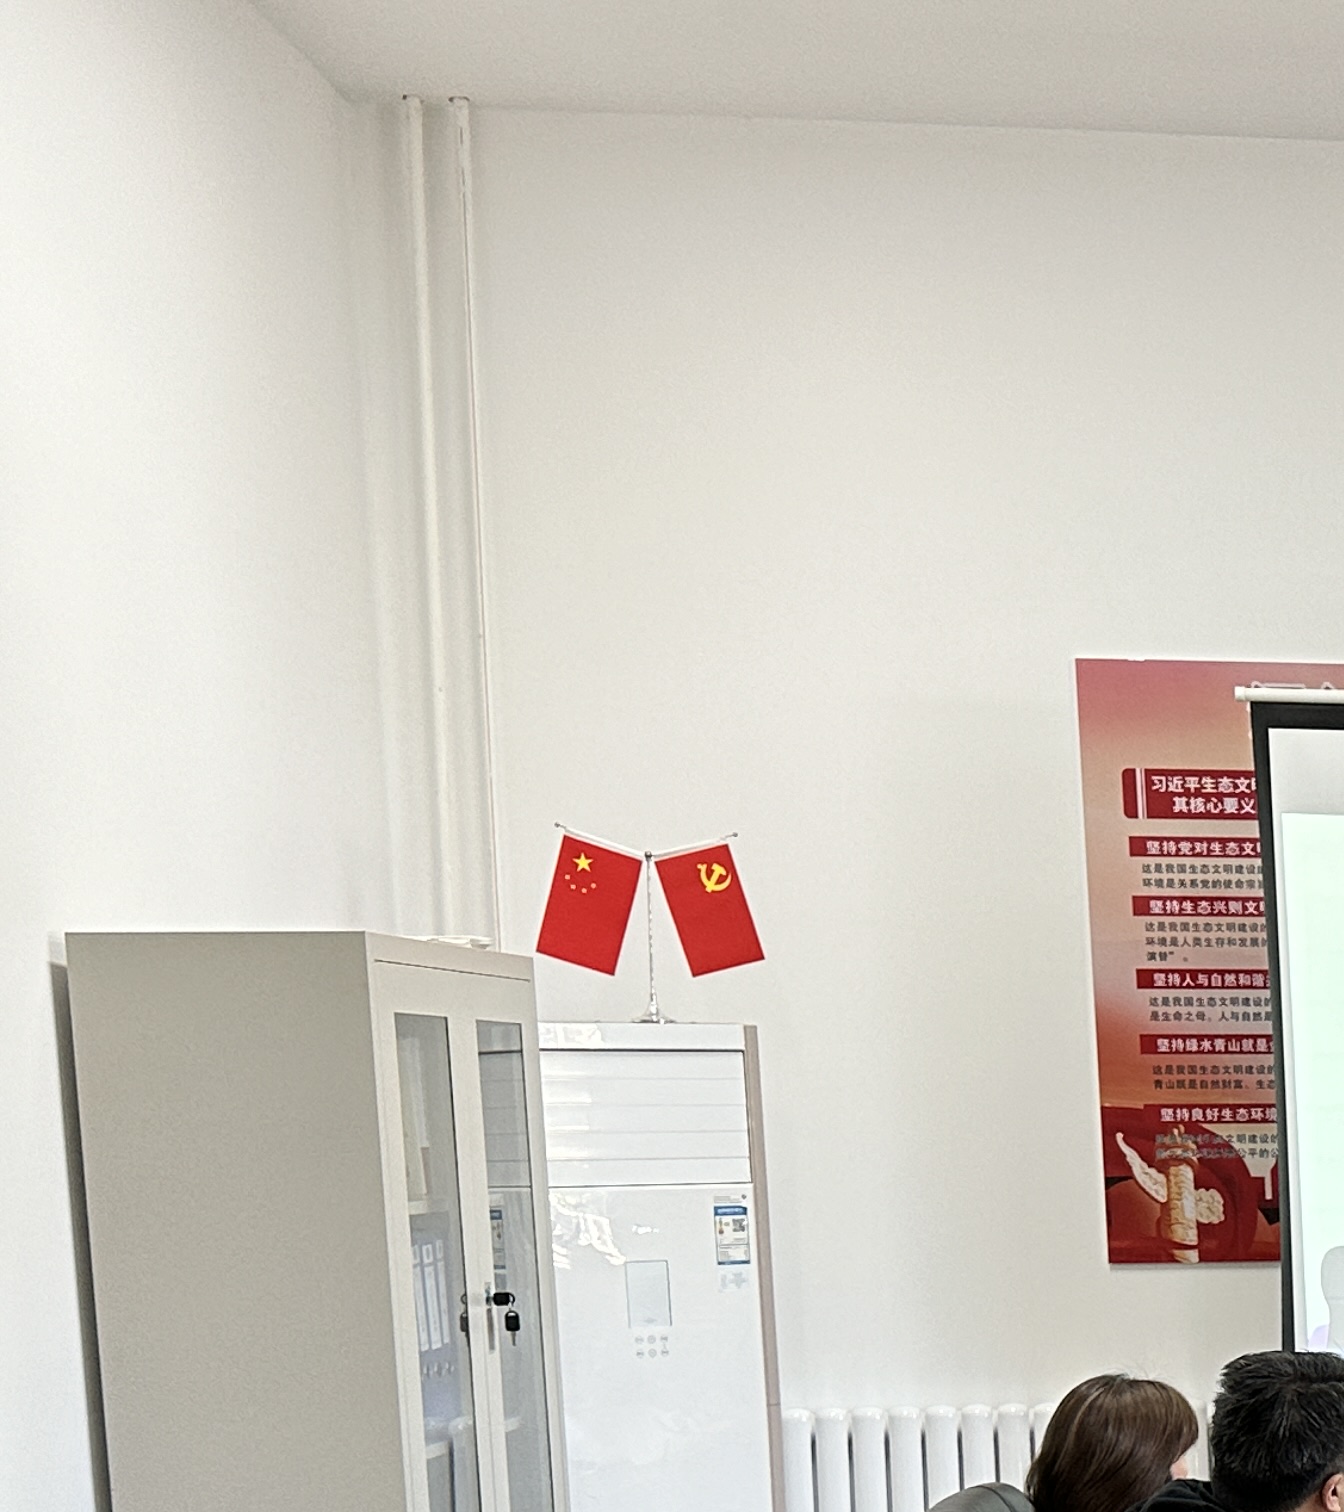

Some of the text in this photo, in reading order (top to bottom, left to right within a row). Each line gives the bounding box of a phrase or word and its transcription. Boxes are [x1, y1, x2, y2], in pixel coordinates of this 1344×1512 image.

[1172, 796, 1256, 814] 其核心要义
[1156, 1038, 1273, 1053] 坚持绿水青山就是
